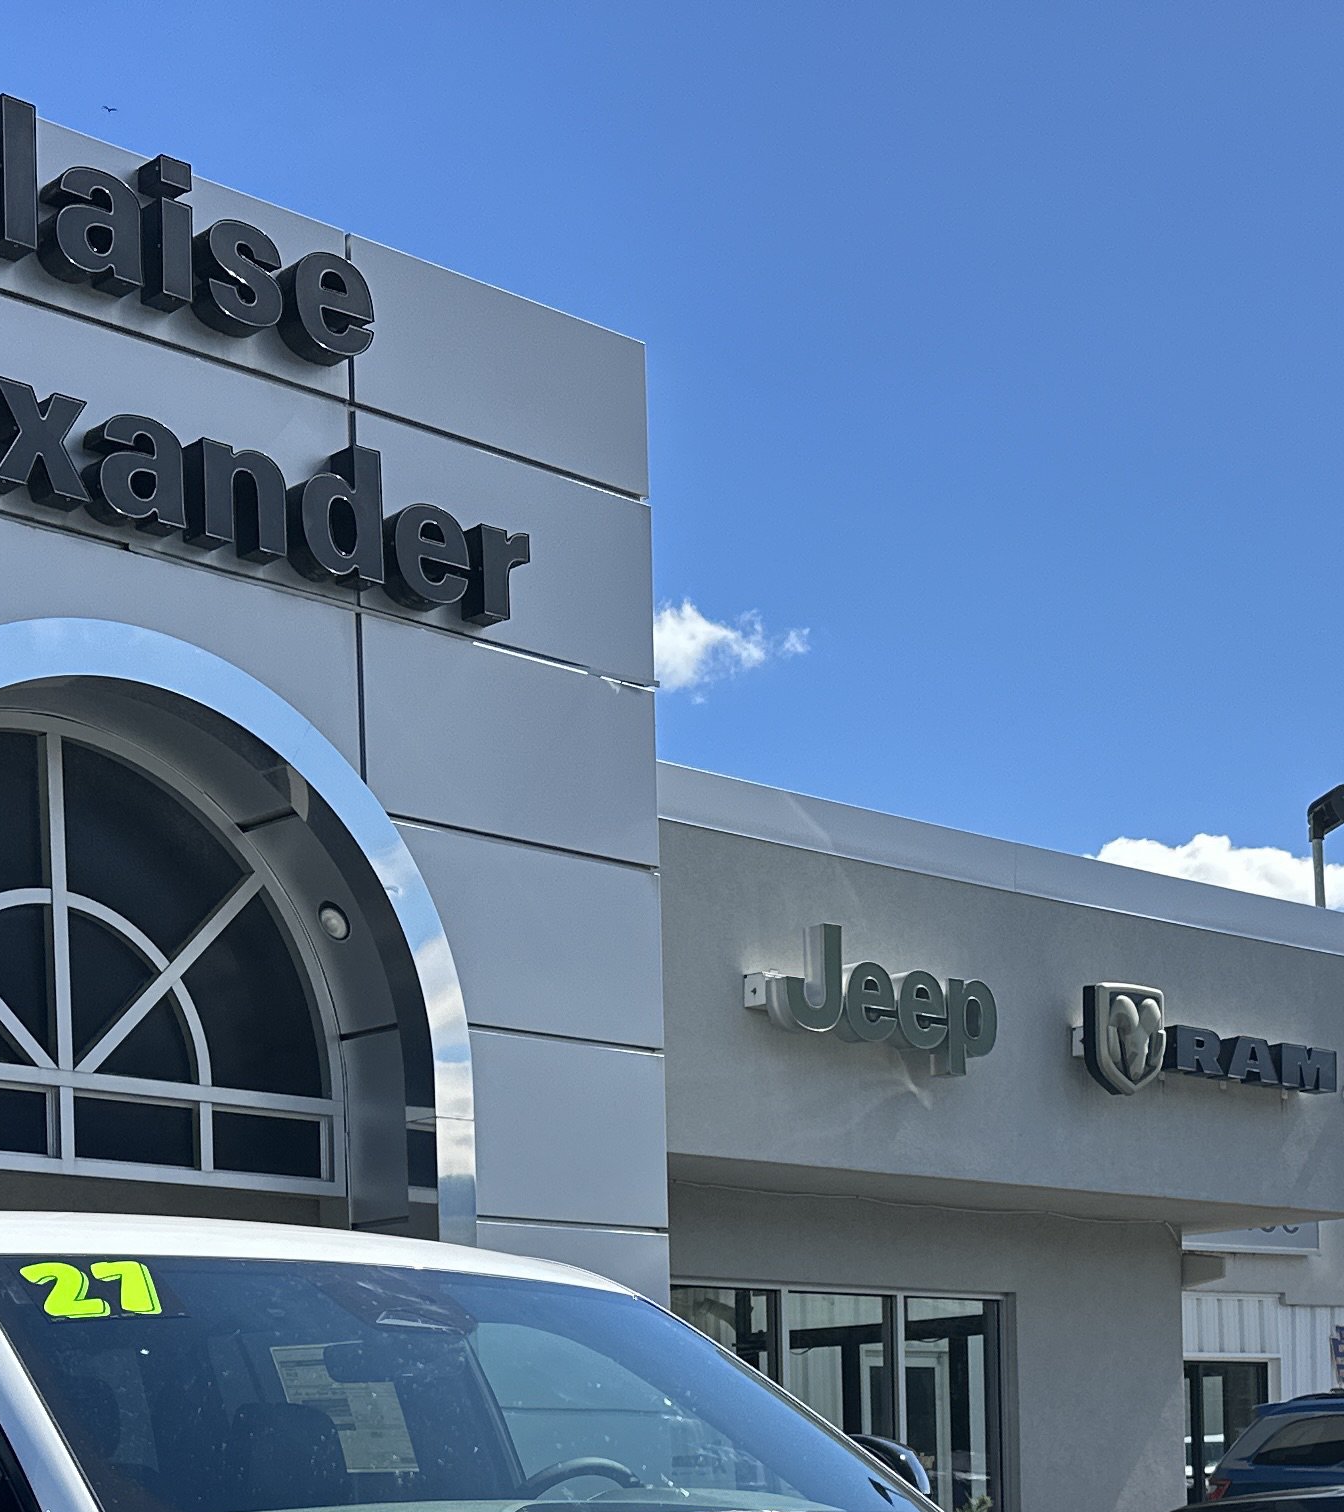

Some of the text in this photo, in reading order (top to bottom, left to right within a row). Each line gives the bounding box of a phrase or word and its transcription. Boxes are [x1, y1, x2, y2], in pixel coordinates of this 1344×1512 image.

[766, 923, 998, 1078] Jeep
[1164, 1024, 1337, 1094] RAM
[19, 1260, 163, 1319] 27
